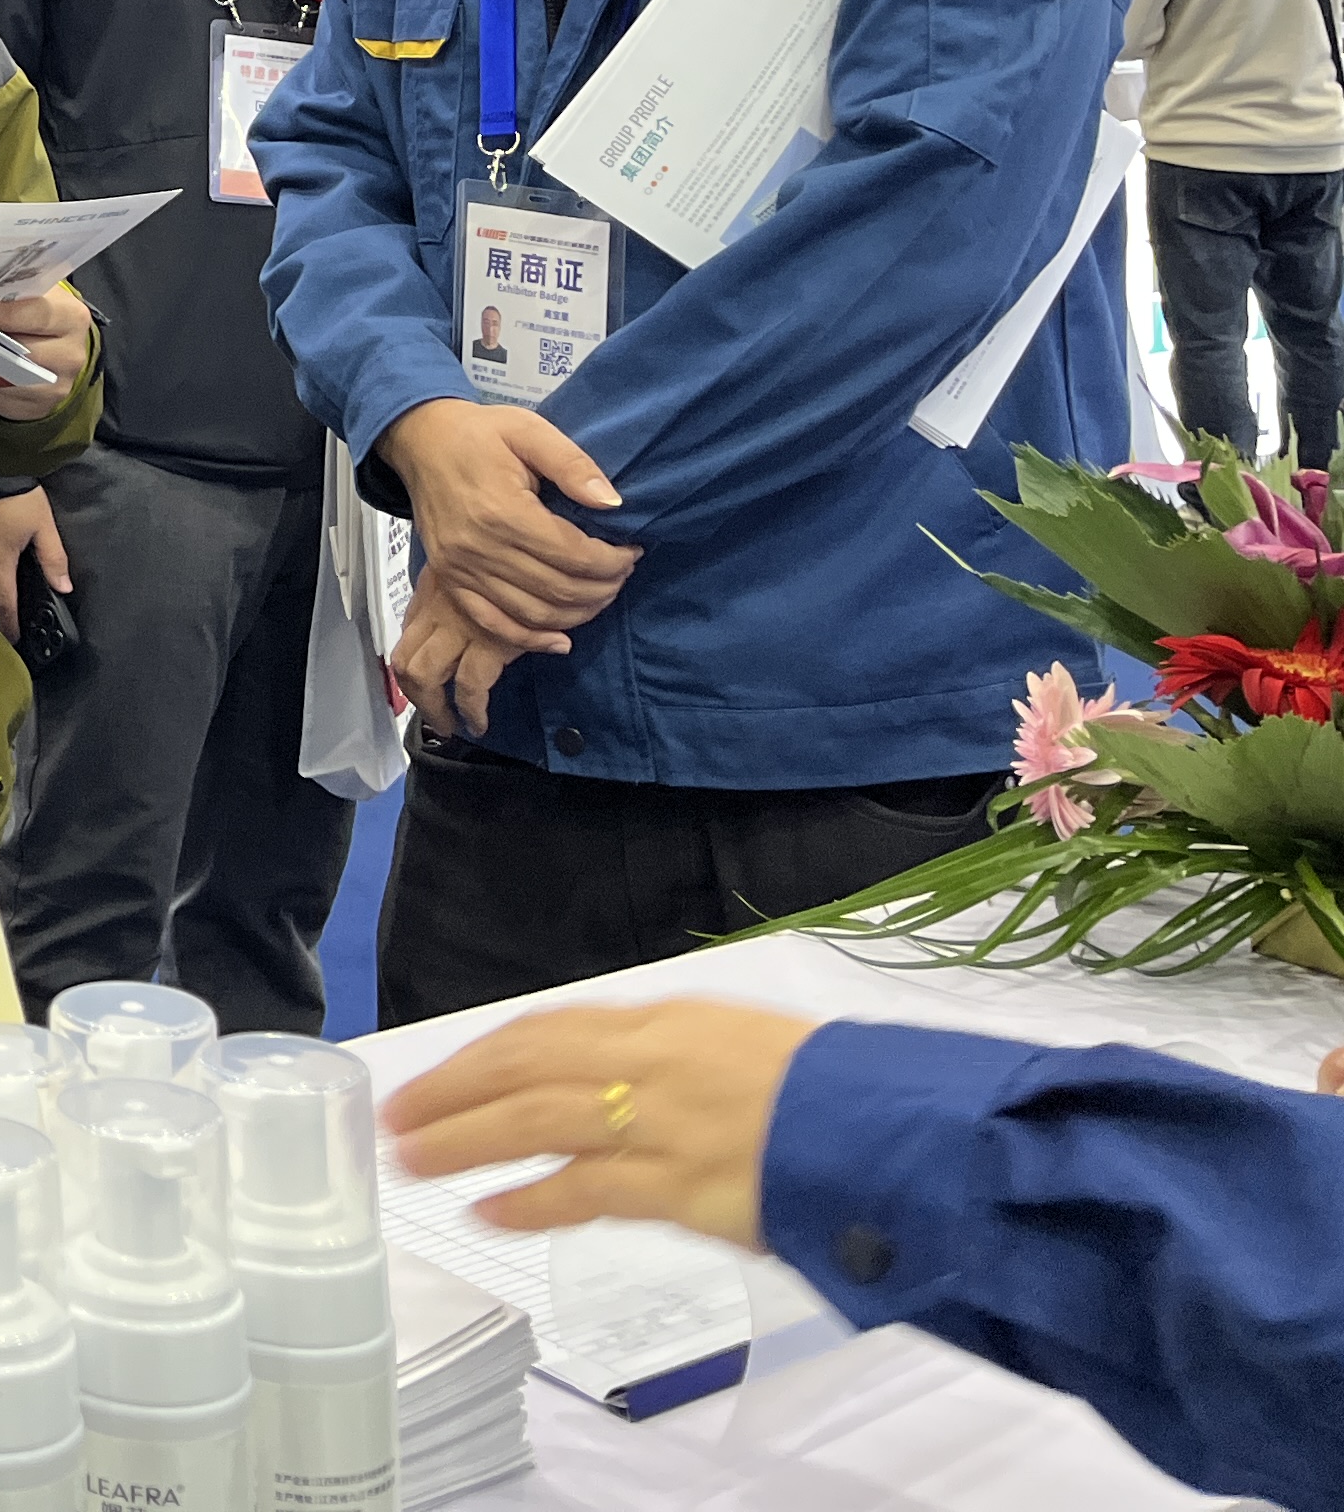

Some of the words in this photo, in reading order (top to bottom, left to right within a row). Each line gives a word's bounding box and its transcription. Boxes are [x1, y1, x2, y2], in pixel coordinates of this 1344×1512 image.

[599, 124, 635, 168] GROUP
[628, 73, 674, 128] PROFILE
[620, 115, 674, 182] 集团简介
[486, 247, 584, 293] 展商证
[497, 282, 537, 298] Exhibitor
[539, 289, 569, 304] Badge
[86, 1472, 180, 1506] LEAFRA
